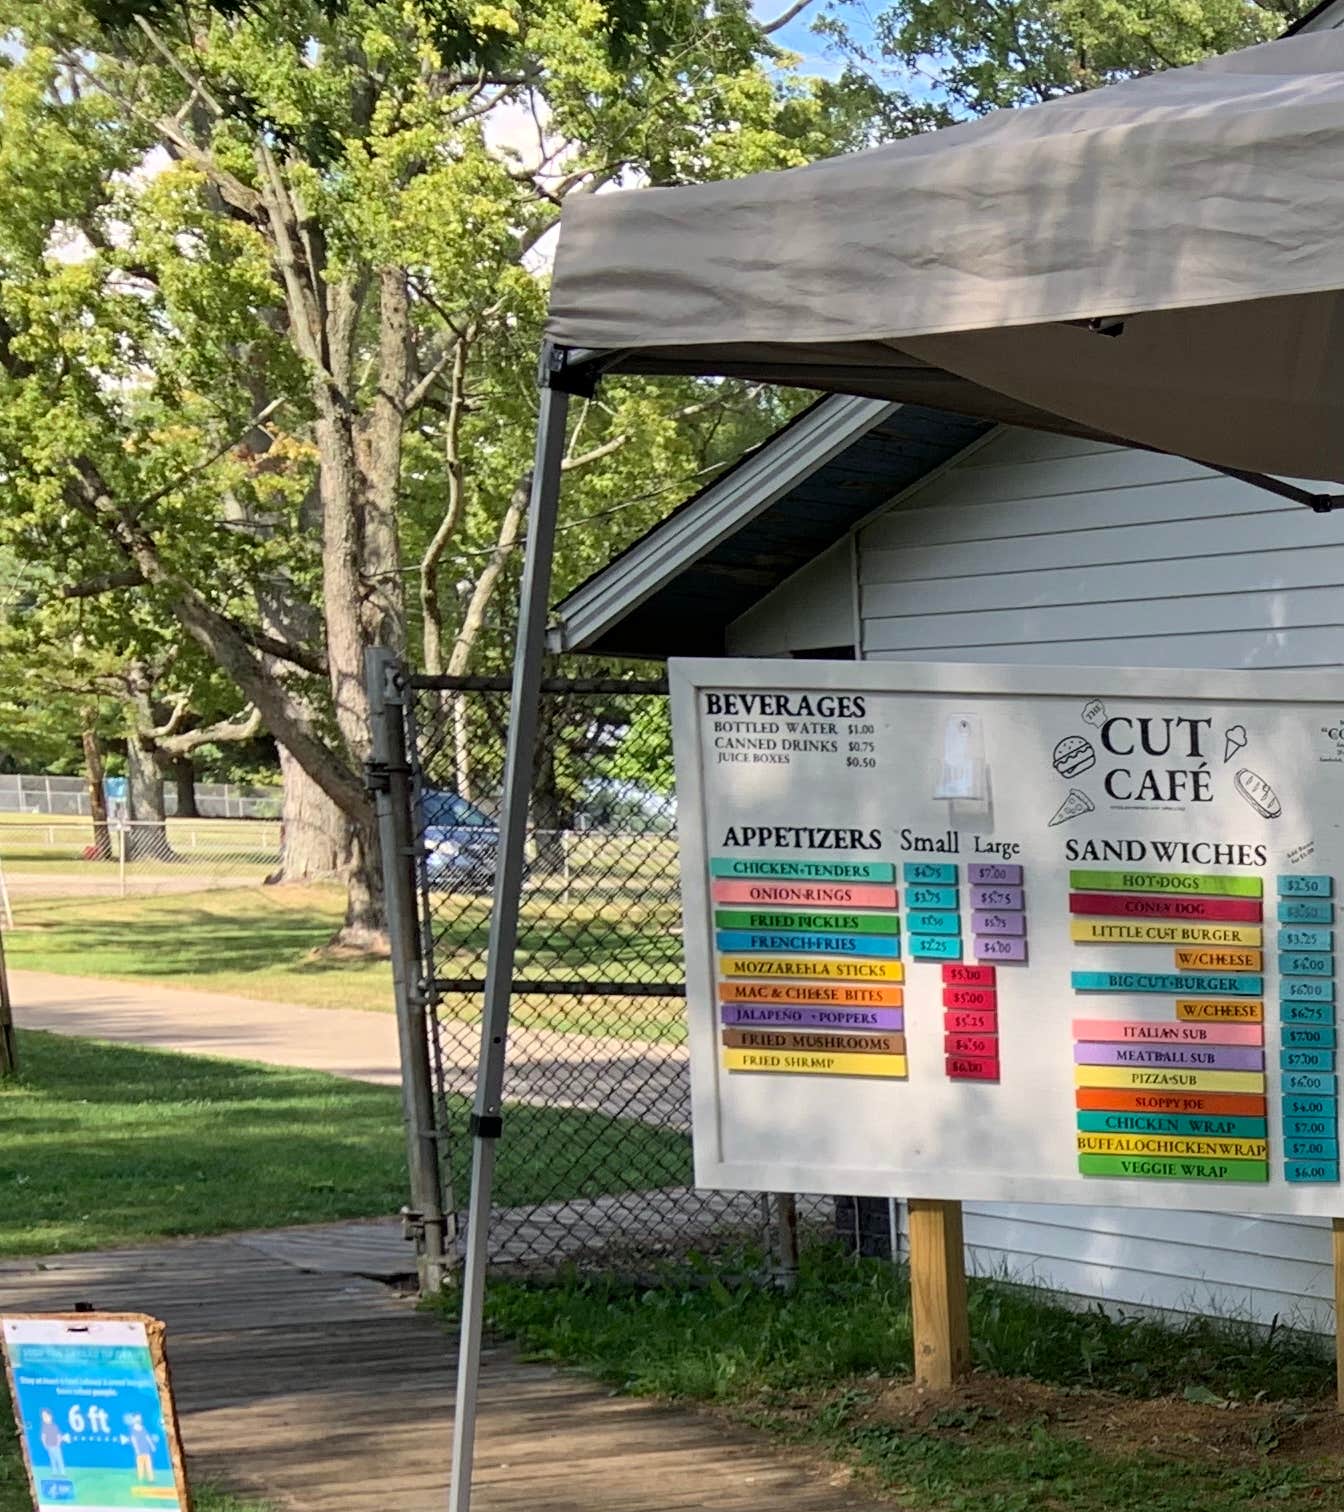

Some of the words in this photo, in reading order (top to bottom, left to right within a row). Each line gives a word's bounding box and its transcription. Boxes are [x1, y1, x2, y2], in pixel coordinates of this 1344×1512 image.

[706, 693, 866, 718] BEVERAGES
[714, 721, 779, 734] BOTTLED
[785, 722, 838, 735] WATER
[714, 737, 776, 750] CANNED
[782, 739, 838, 752] DRINKS
[1100, 716, 1212, 758] CUT
[718, 752, 750, 763] JUICE
[753, 753, 790, 763] BOXES
[1104, 762, 1214, 802] CAFÉ
[723, 826, 882, 850] APPETIZERS
[900, 829, 960, 854] Small
[974, 836, 1020, 860] Large
[733, 861, 800, 875] CHICKEN
[804, 864, 870, 877] TENDERS
[1122, 874, 1154, 887] HOT
[1160, 877, 1200, 890] DOGS
[750, 888, 801, 900] ONION
[805, 888, 852, 901] RINGS
[1176, 902, 1205, 915] DOG
[1091, 925, 1142, 938] LITTLE
[1145, 928, 1178, 940] CUT
[1181, 928, 1243, 942] BURGER
[750, 936, 811, 950] FRENCH
[817, 937, 856, 950] FRIES
[836, 963, 886, 976] STICKS
[1108, 975, 1134, 987] BIG
[1137, 976, 1169, 988] CUT
[1176, 977, 1239, 991] BURGER
[735, 986, 768, 998] MAC
[771, 987, 781, 998] &
[845, 989, 883, 1001] BITES
[819, 1012, 878, 1024] POPPERS
[741, 1032, 786, 1047] FRIED
[792, 1035, 890, 1050] MUSHROOMS
[1123, 1027, 1179, 1039] ITALIAN
[1182, 1028, 1208, 1040] SUB
[742, 1055, 780, 1067] FRIED
[1116, 1050, 1188, 1063] MEATBALL
[1190, 1053, 1215, 1064] SUB
[1131, 1073, 1169, 1085] PIZZA
[1173, 1075, 1197, 1086] SUB
[1135, 1097, 1181, 1108] SLOPPY
[1183, 1099, 1204, 1111] JOE
[1105, 1116, 1179, 1131] CHICKEN
[1189, 1119, 1236, 1133] WRAP
[1121, 1160, 1177, 1175] VEGGIE
[1180, 1164, 1228, 1178] WRAP
[68, 1404, 84, 1432] 6
[87, 1405, 111, 1434] ft
